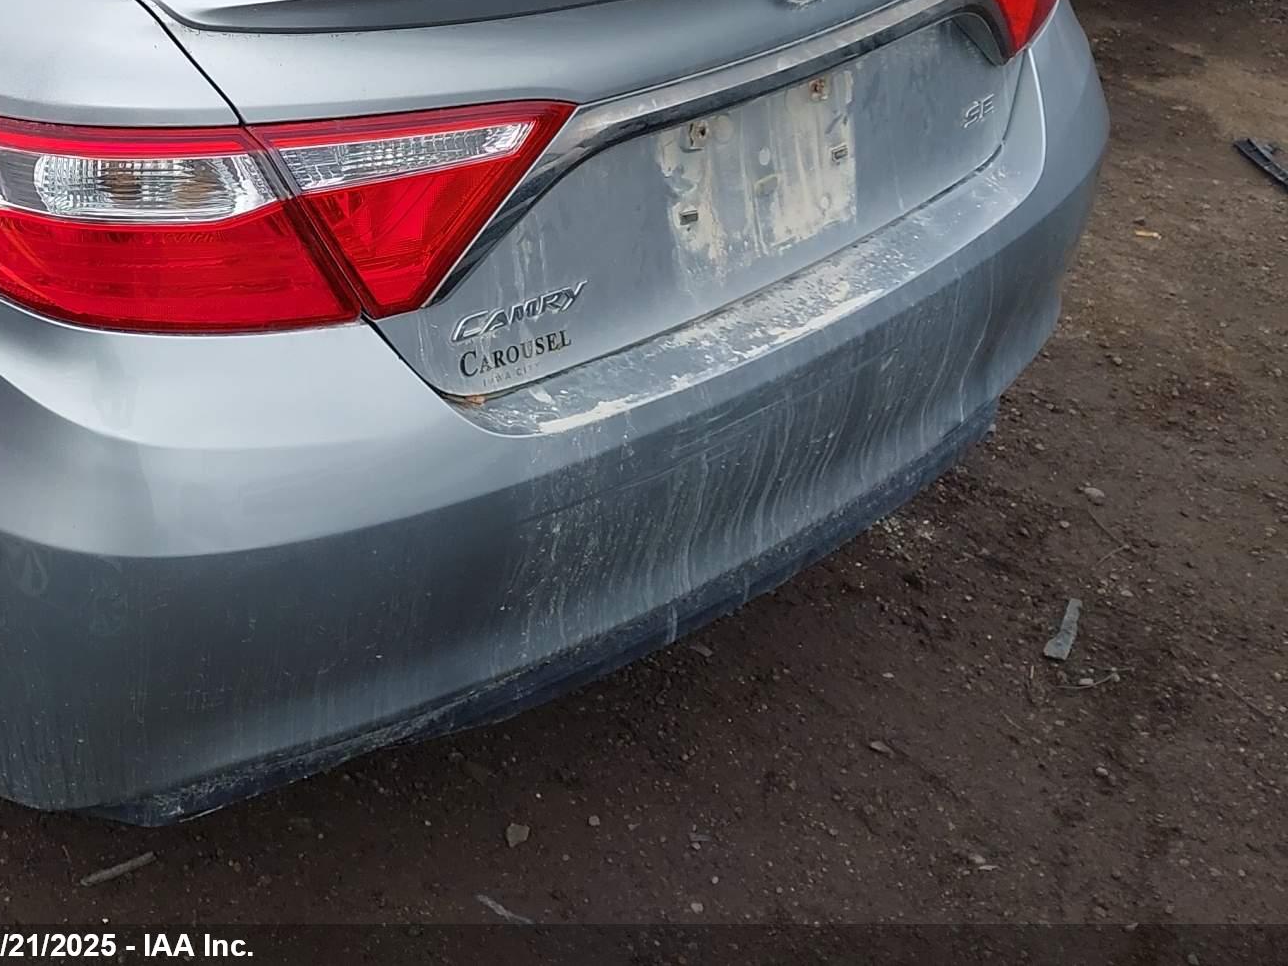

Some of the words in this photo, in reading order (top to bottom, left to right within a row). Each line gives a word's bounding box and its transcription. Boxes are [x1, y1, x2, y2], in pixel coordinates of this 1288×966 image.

[961, 94, 994, 129] SE
[451, 279, 588, 342] CAMRY
[459, 330, 572, 377] CAROUSEL
